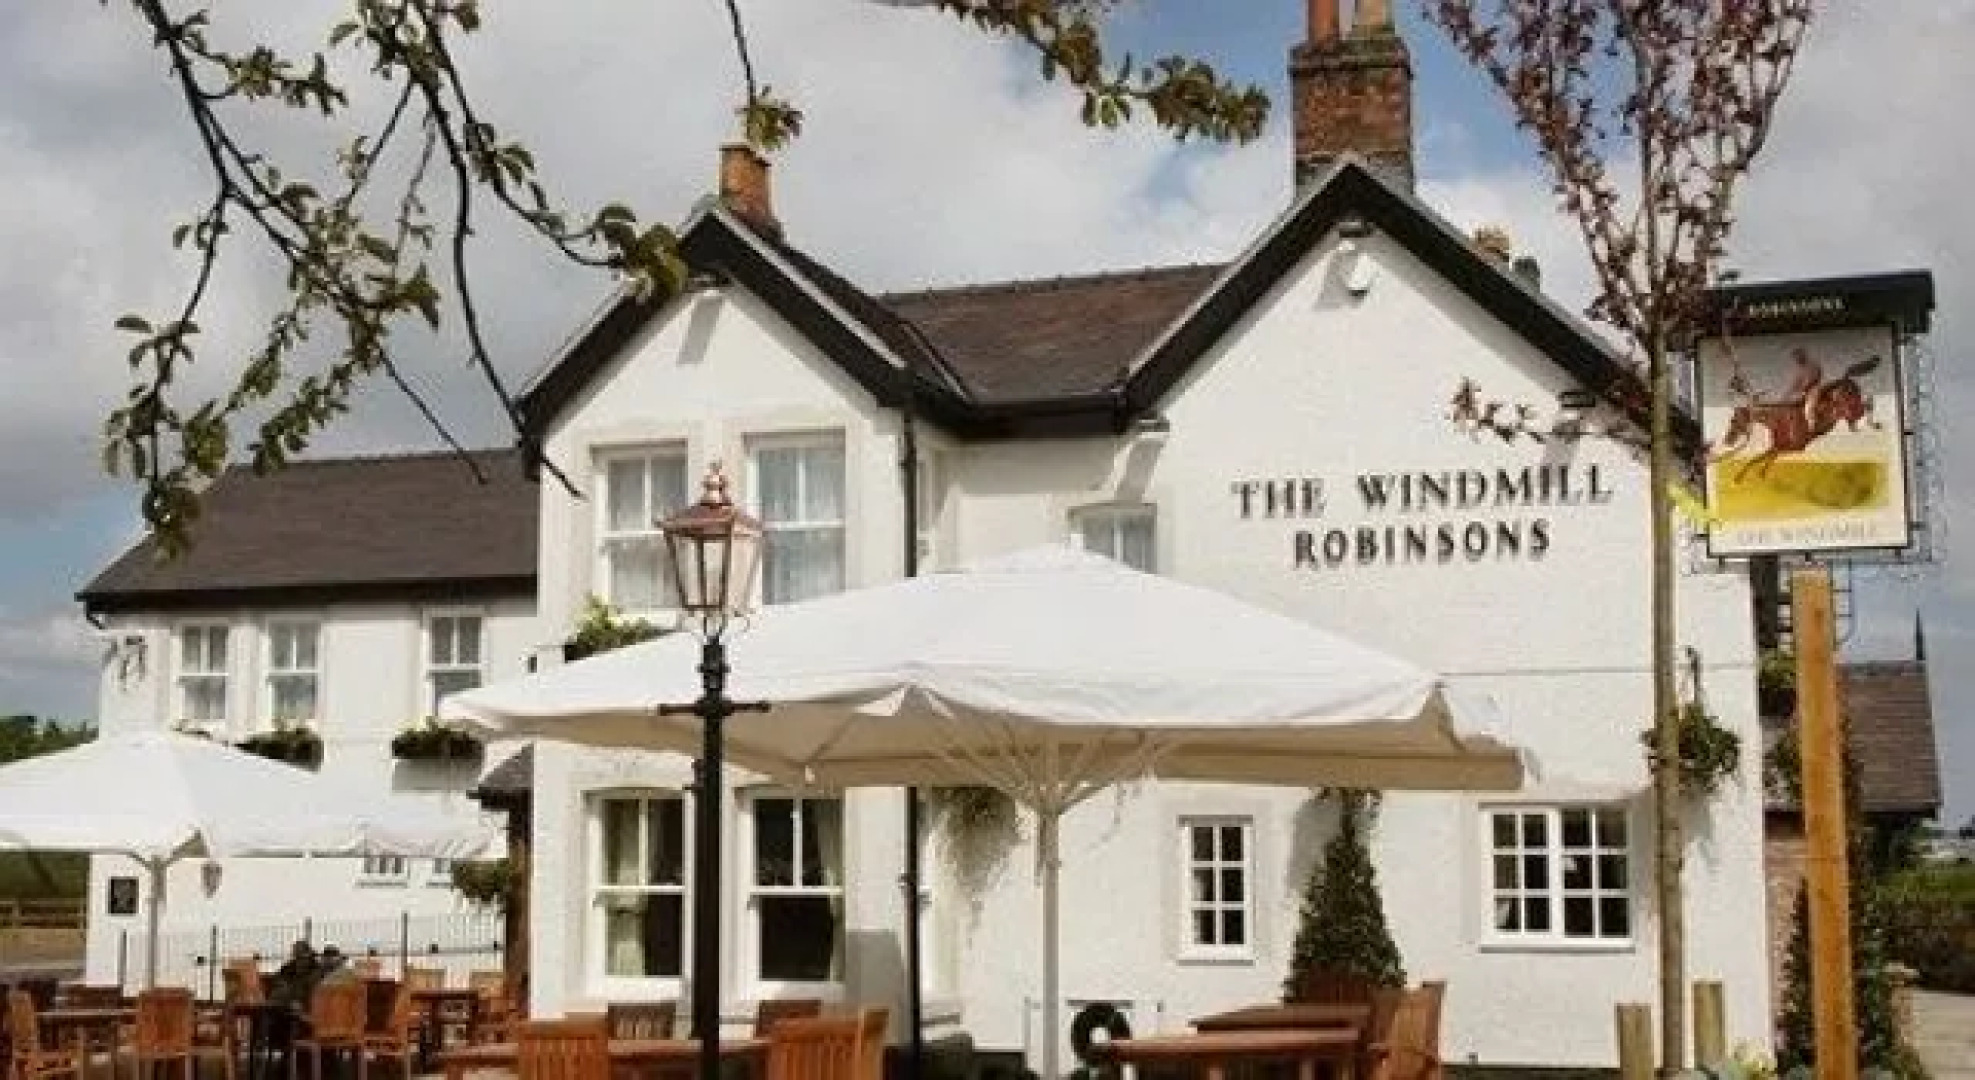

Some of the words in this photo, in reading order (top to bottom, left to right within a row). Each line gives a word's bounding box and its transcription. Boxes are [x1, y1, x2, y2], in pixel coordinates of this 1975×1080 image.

[1231, 478, 1326, 519] THE
[1357, 463, 1614, 511] WINDMILL
[1294, 517, 1552, 571] ROBINSONS
